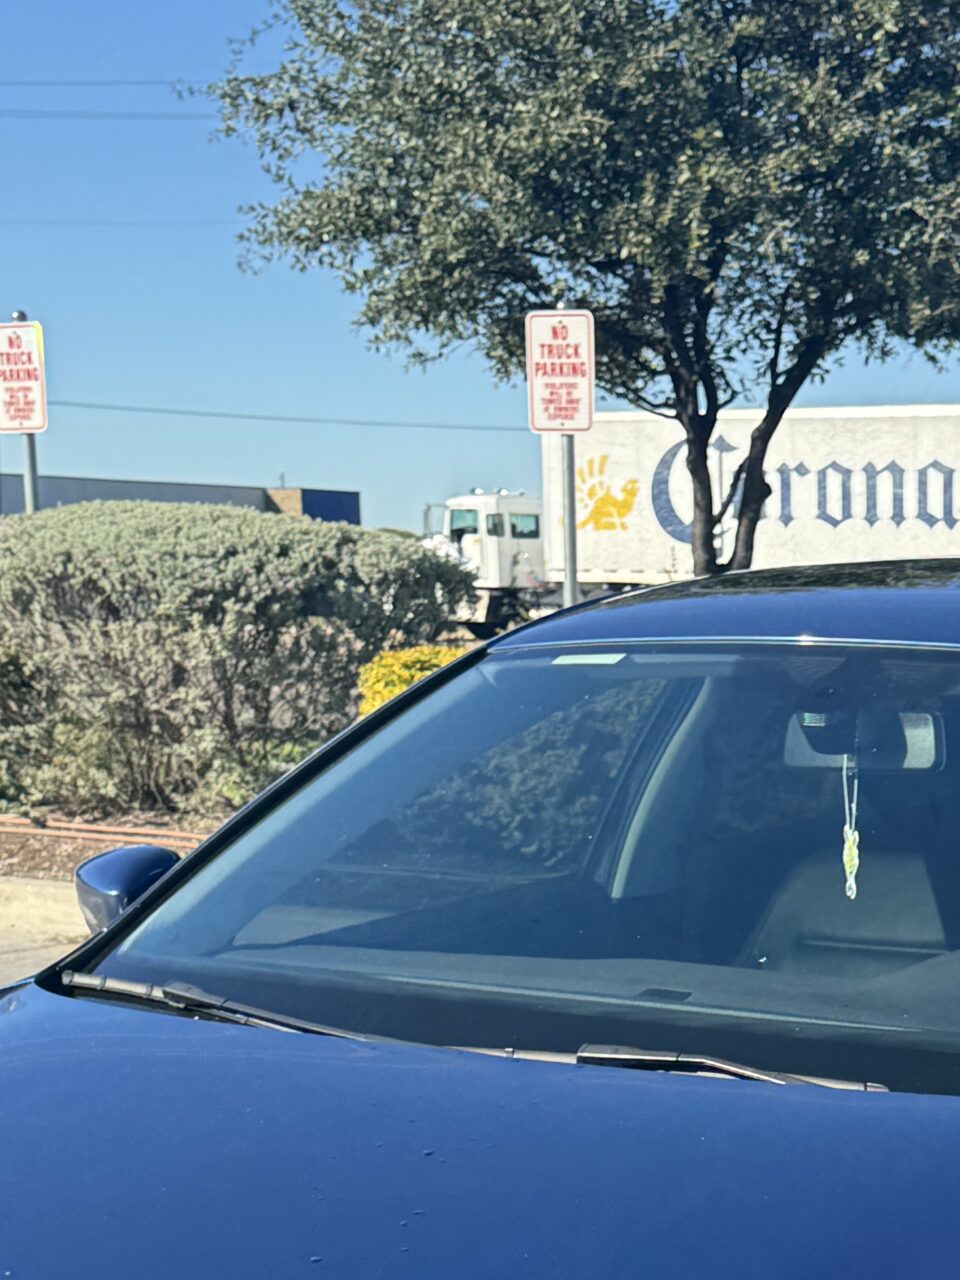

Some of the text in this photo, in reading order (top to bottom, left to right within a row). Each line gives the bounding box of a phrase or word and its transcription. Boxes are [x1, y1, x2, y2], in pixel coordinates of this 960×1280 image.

[551, 325, 569, 341] NO
[7, 334, 23, 350] NO
[0, 351, 33, 366] TRUCK
[539, 343, 582, 360] TRUCK
[535, 361, 587, 378] PARKING
